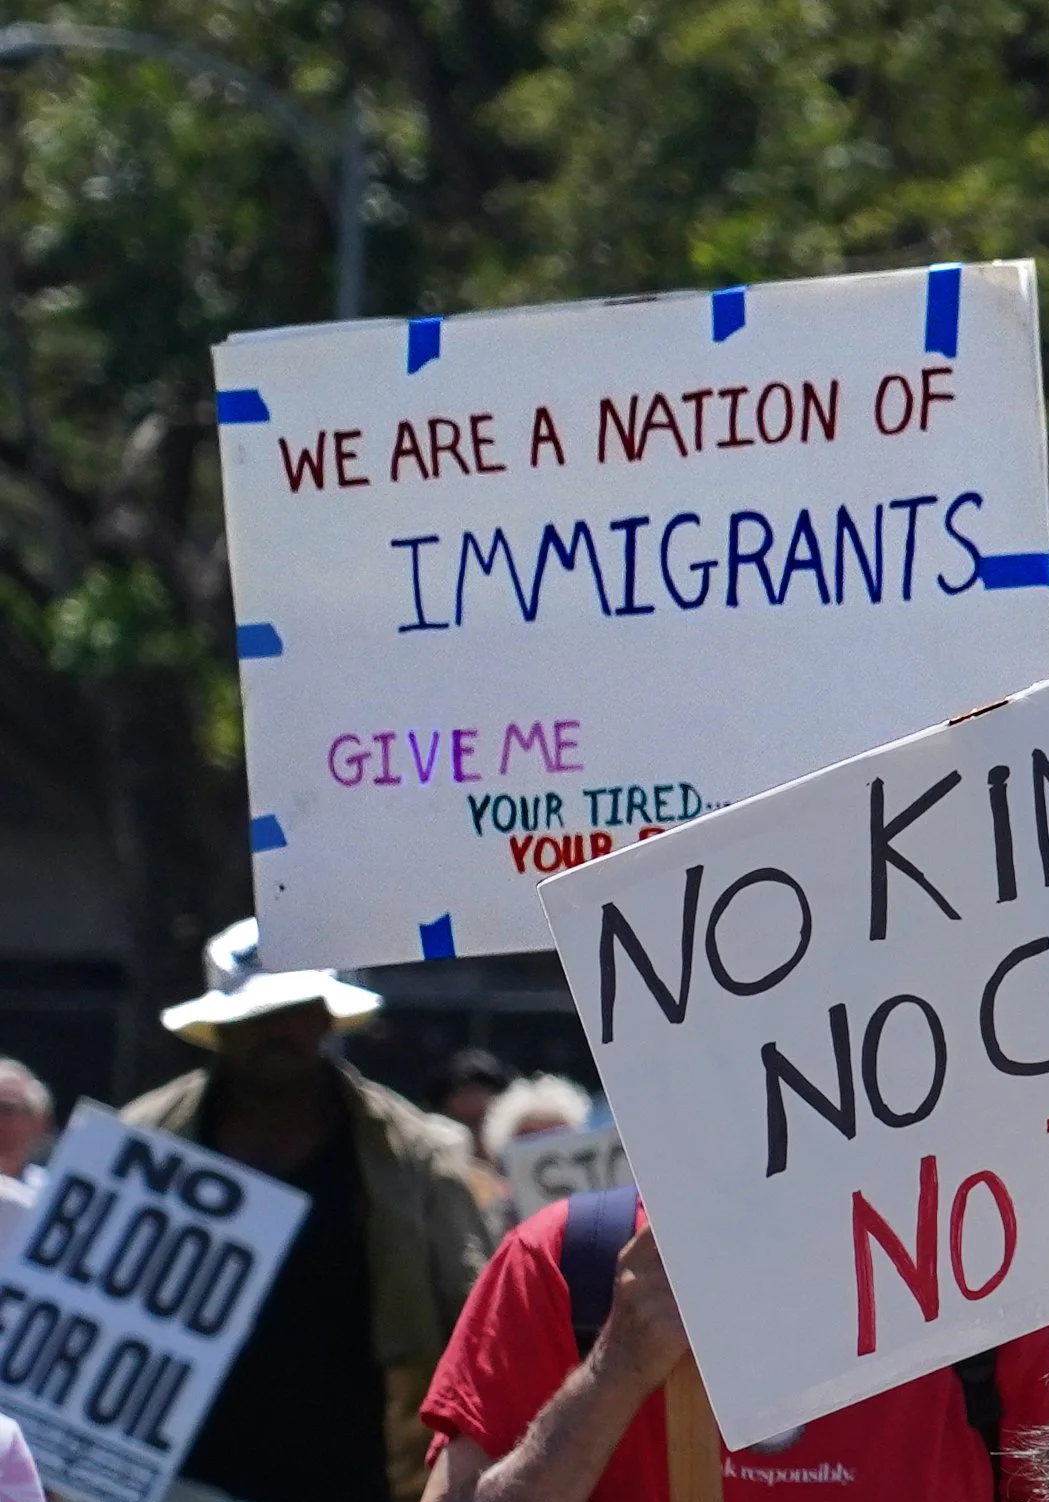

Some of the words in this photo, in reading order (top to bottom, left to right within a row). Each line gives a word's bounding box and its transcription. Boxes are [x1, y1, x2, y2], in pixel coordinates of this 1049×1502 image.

[279, 429, 370, 494] WE
[389, 414, 506, 483] ARE
[530, 406, 565, 468] A
[598, 379, 839, 464] NATION
[874, 366, 955, 435] OF
[391, 491, 985, 633] IMMIGRANTS
[328, 728, 482, 788] GIVE
[499, 720, 584, 775] ME
[466, 791, 565, 836] YOUR
[509, 831, 614, 875] YOUR
[599, 864, 813, 1044] NO
[762, 993, 948, 1177] NO
[112, 1135, 245, 1218] NO
[27, 1175, 255, 1340] BLOOD
[854, 1154, 1018, 1357] NO
[87, 1339, 194, 1451] OIL
